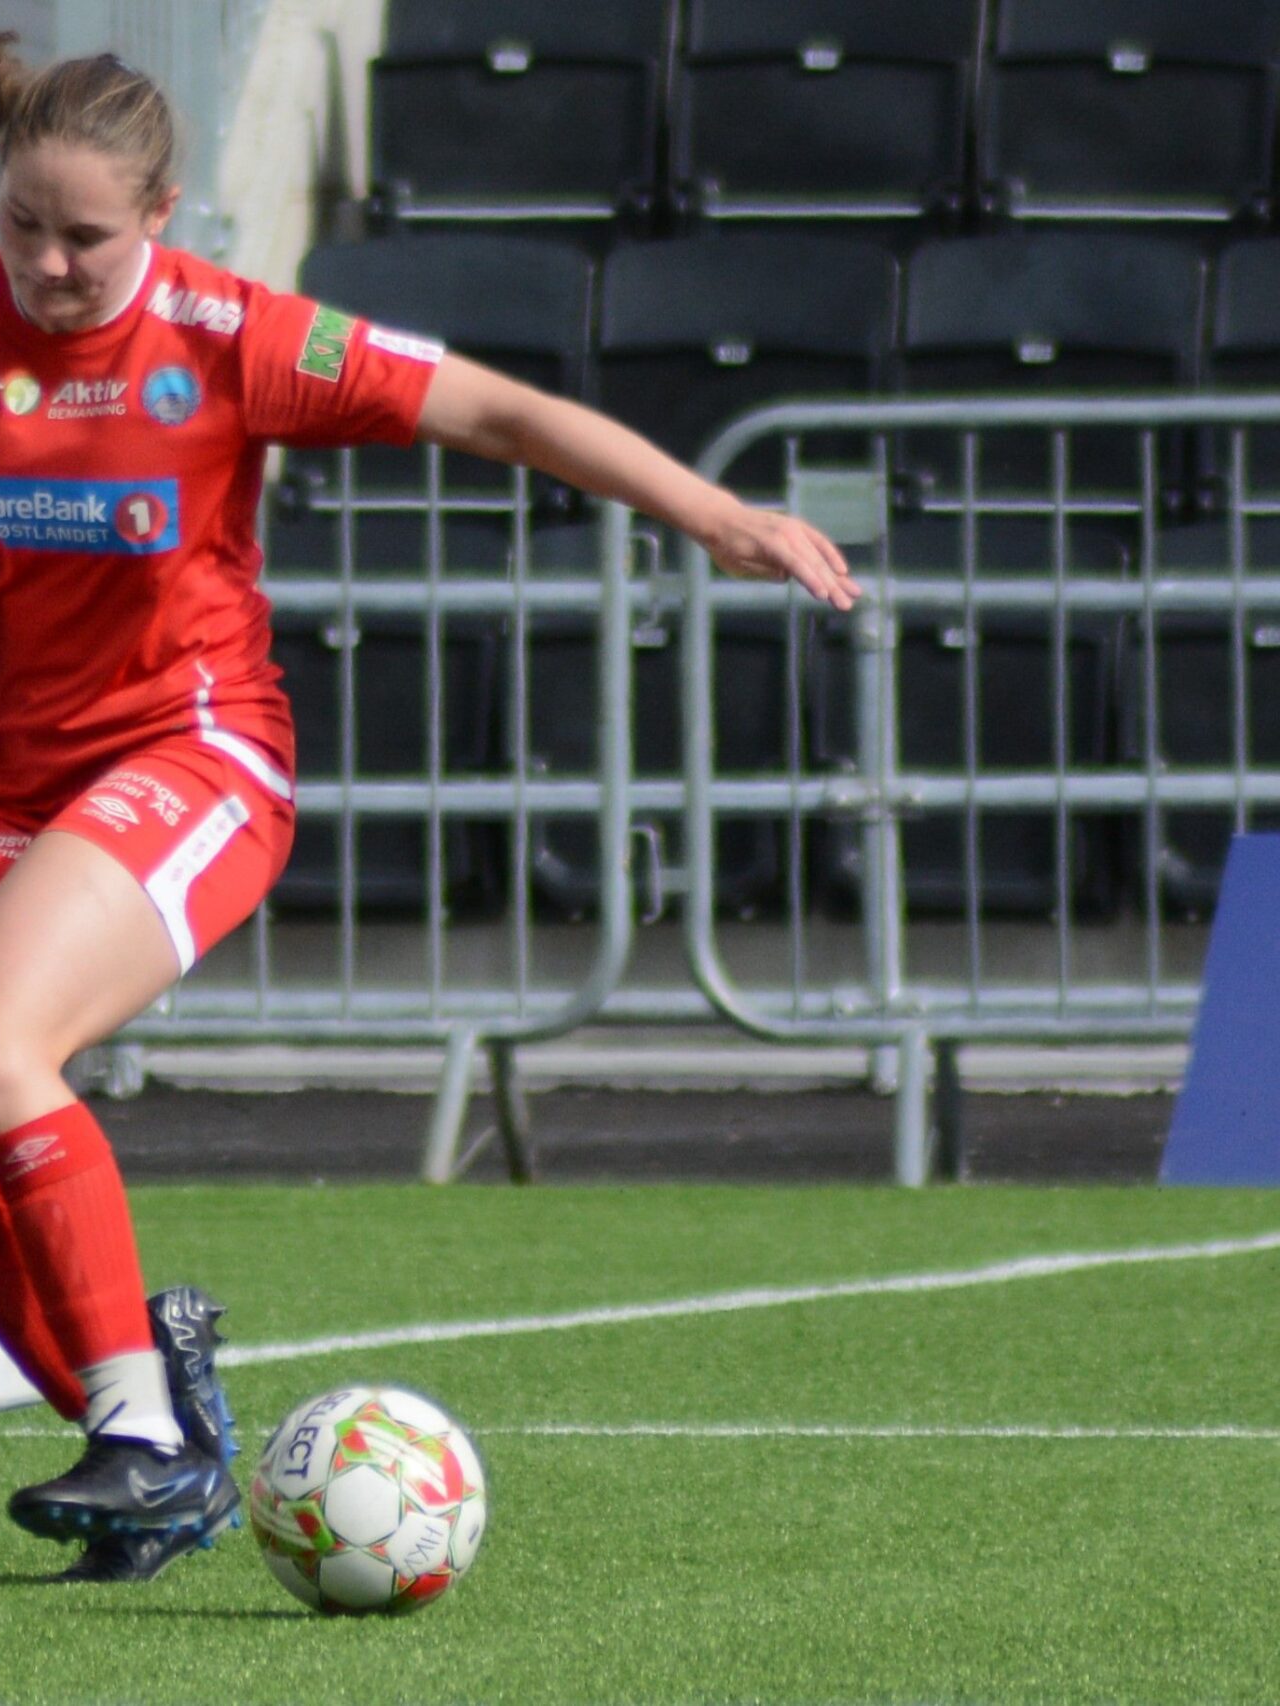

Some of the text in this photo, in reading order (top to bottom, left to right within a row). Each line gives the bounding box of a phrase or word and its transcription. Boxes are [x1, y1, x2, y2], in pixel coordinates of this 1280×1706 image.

[51, 380, 129, 405] Aktiv
[47, 403, 128, 421] BEMANNING
[128, 499, 151, 537] 1
[148, 801, 180, 828] AS
[283, 1391, 352, 1480] SELECT
